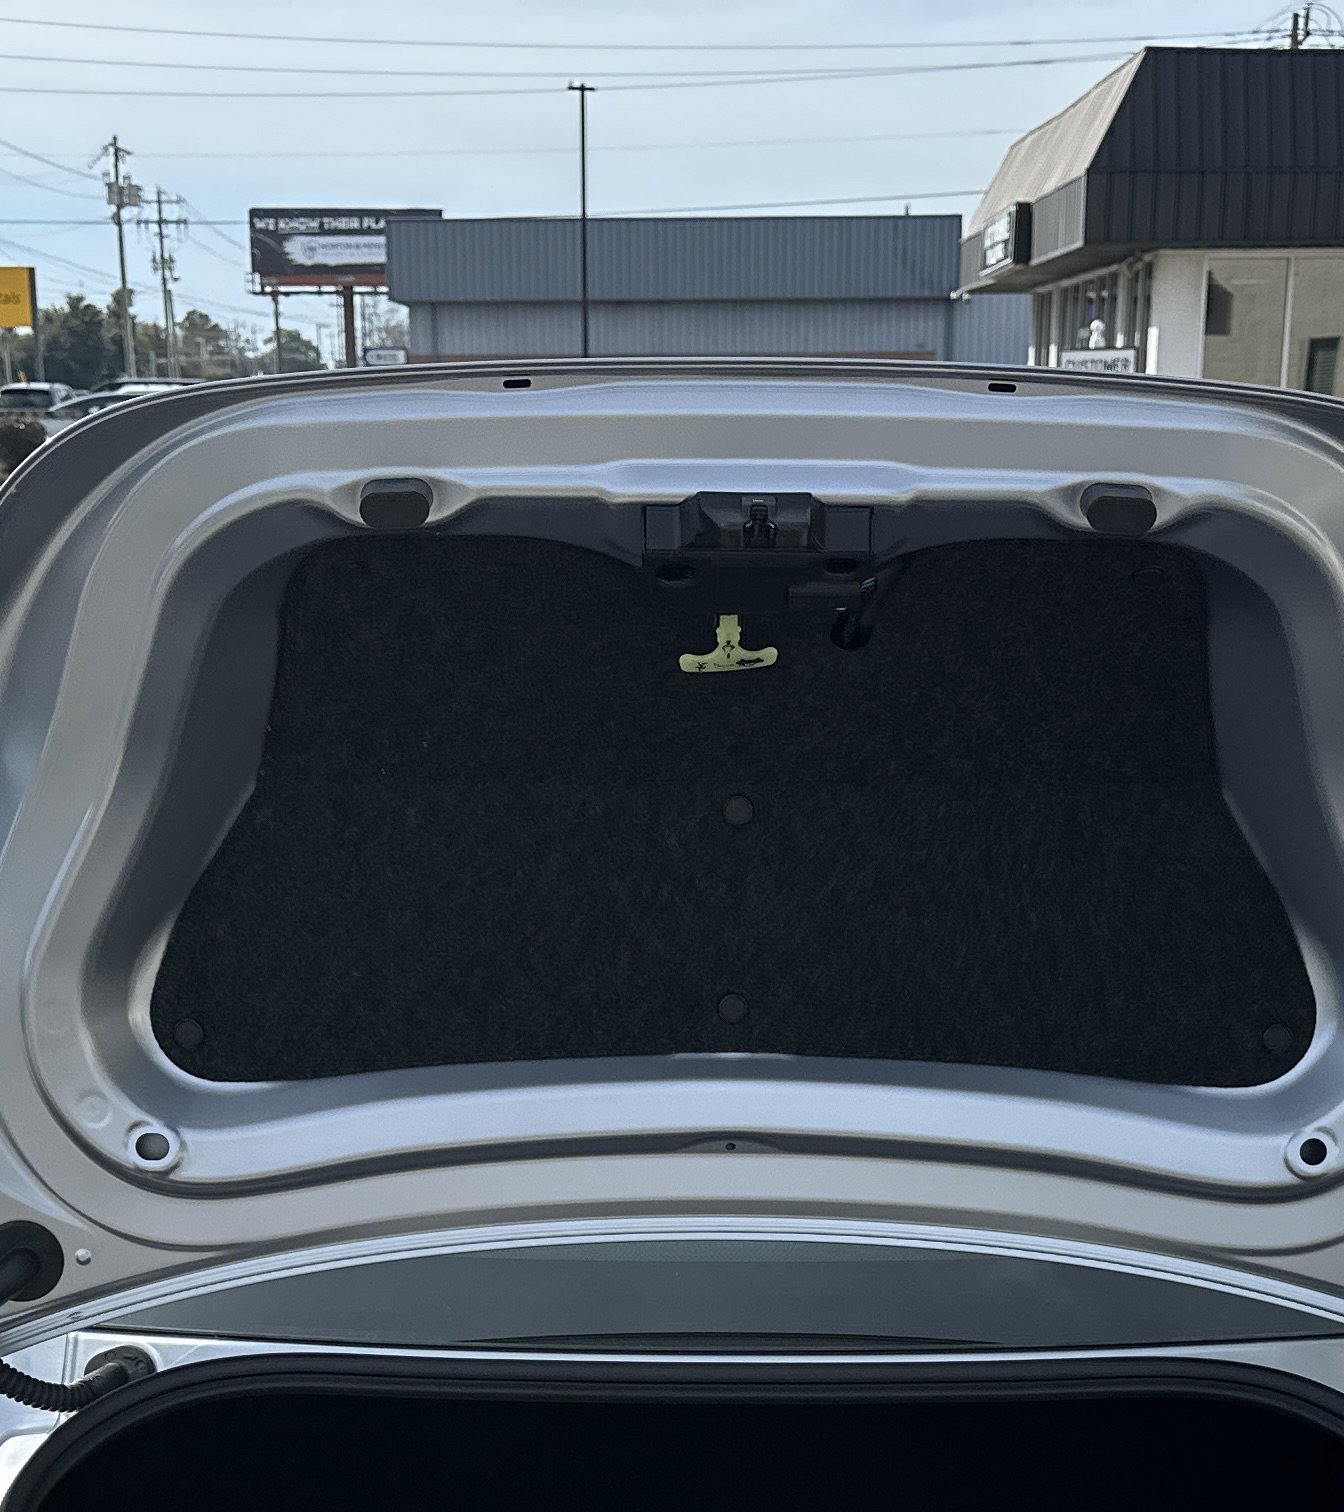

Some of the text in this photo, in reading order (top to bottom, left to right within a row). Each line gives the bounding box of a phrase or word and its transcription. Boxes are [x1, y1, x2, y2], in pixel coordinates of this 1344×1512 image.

[253, 217, 276, 231] WE
[278, 217, 320, 231] KNOW
[323, 217, 360, 230] THEIR
